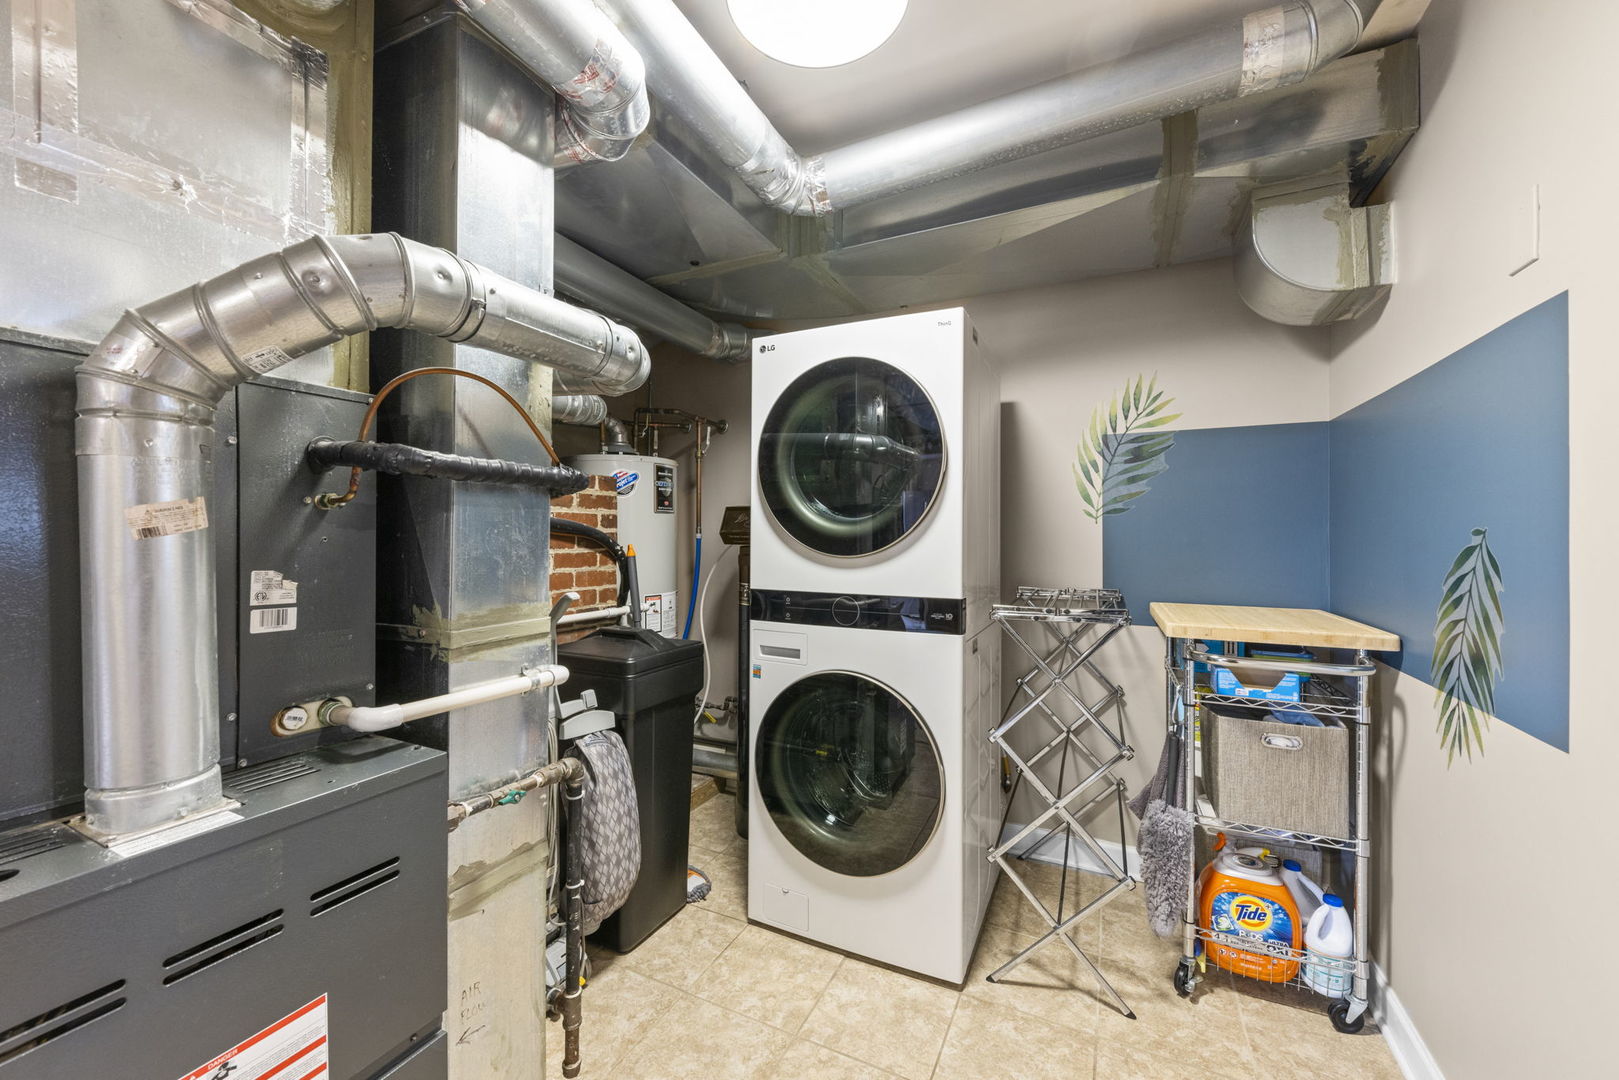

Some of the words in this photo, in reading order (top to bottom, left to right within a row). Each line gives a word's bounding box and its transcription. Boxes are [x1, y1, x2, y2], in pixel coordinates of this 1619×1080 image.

[767, 344, 776, 352] LG
[1236, 904, 1267, 921] Tide
[461, 981, 481, 1006] AIR
[207, 1049, 239, 1070] DANGER
